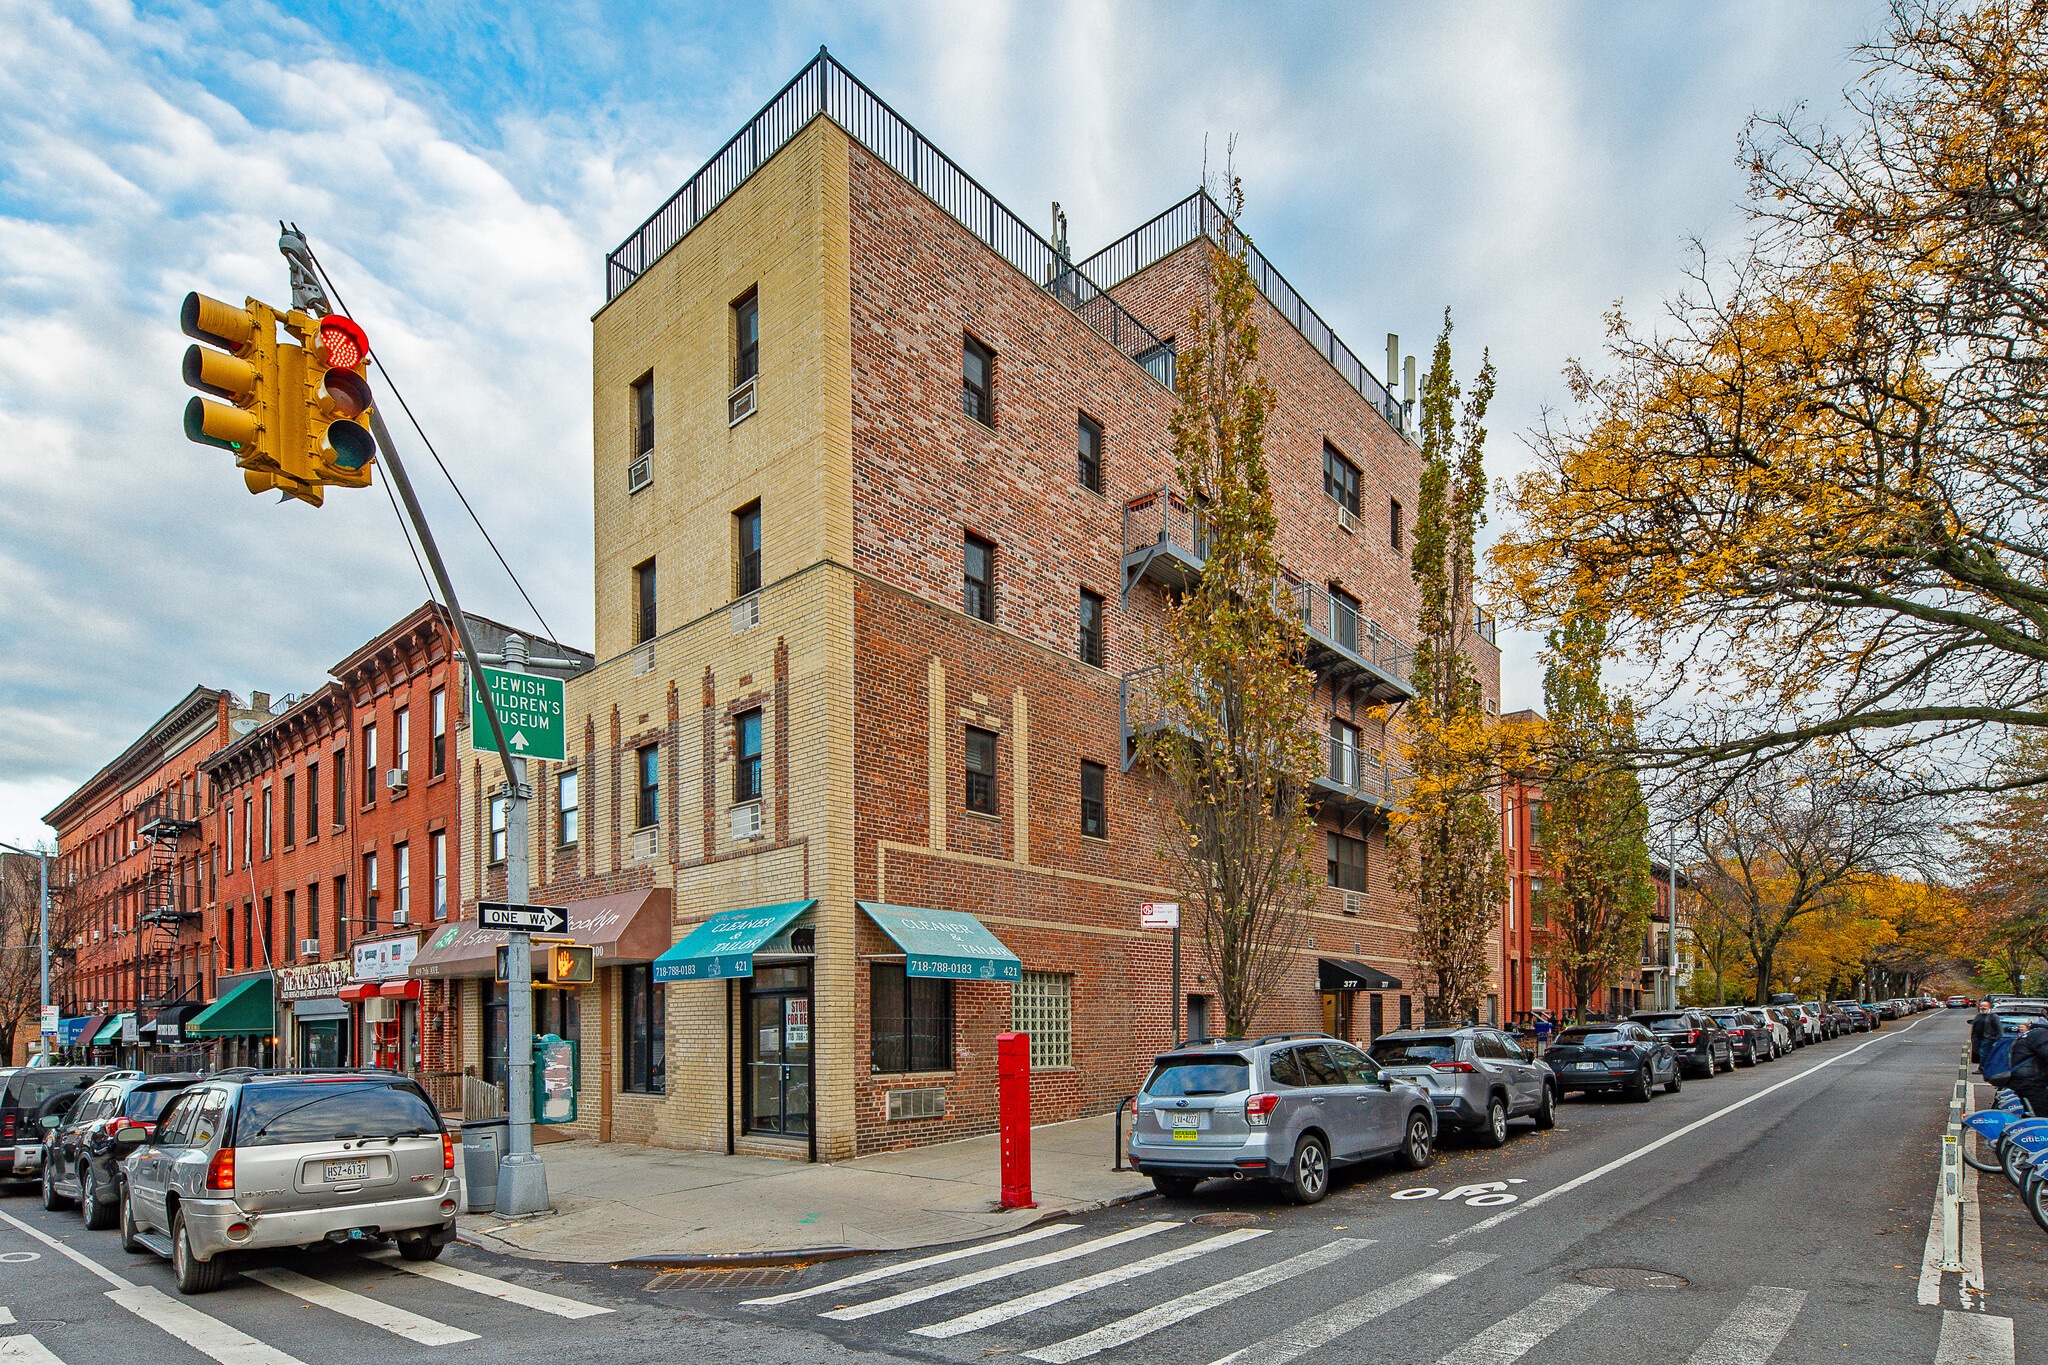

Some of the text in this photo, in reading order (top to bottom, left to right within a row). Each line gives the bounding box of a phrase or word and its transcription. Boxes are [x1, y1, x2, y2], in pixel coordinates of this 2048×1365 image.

[491, 675, 546, 697] JEWISH
[496, 709, 550, 730] USEUM
[492, 911, 555, 926] ONE WAY
[711, 917, 776, 933] CLEANER
[901, 918, 975, 935] CLEANER
[729, 931, 743, 940] &
[950, 933, 964, 942] &
[710, 938, 762, 953] TAILOR
[958, 943, 1012, 957] TAILOR
[655, 960, 748, 977] 718-788-0183 421
[911, 960, 1018, 977] 718-788-0183 421
[1343, 980, 1358, 988] 377
[791, 1000, 807, 1013] STOR
[787, 1013, 799, 1025] FOR
[2021, 1135, 2035, 1143] citi
